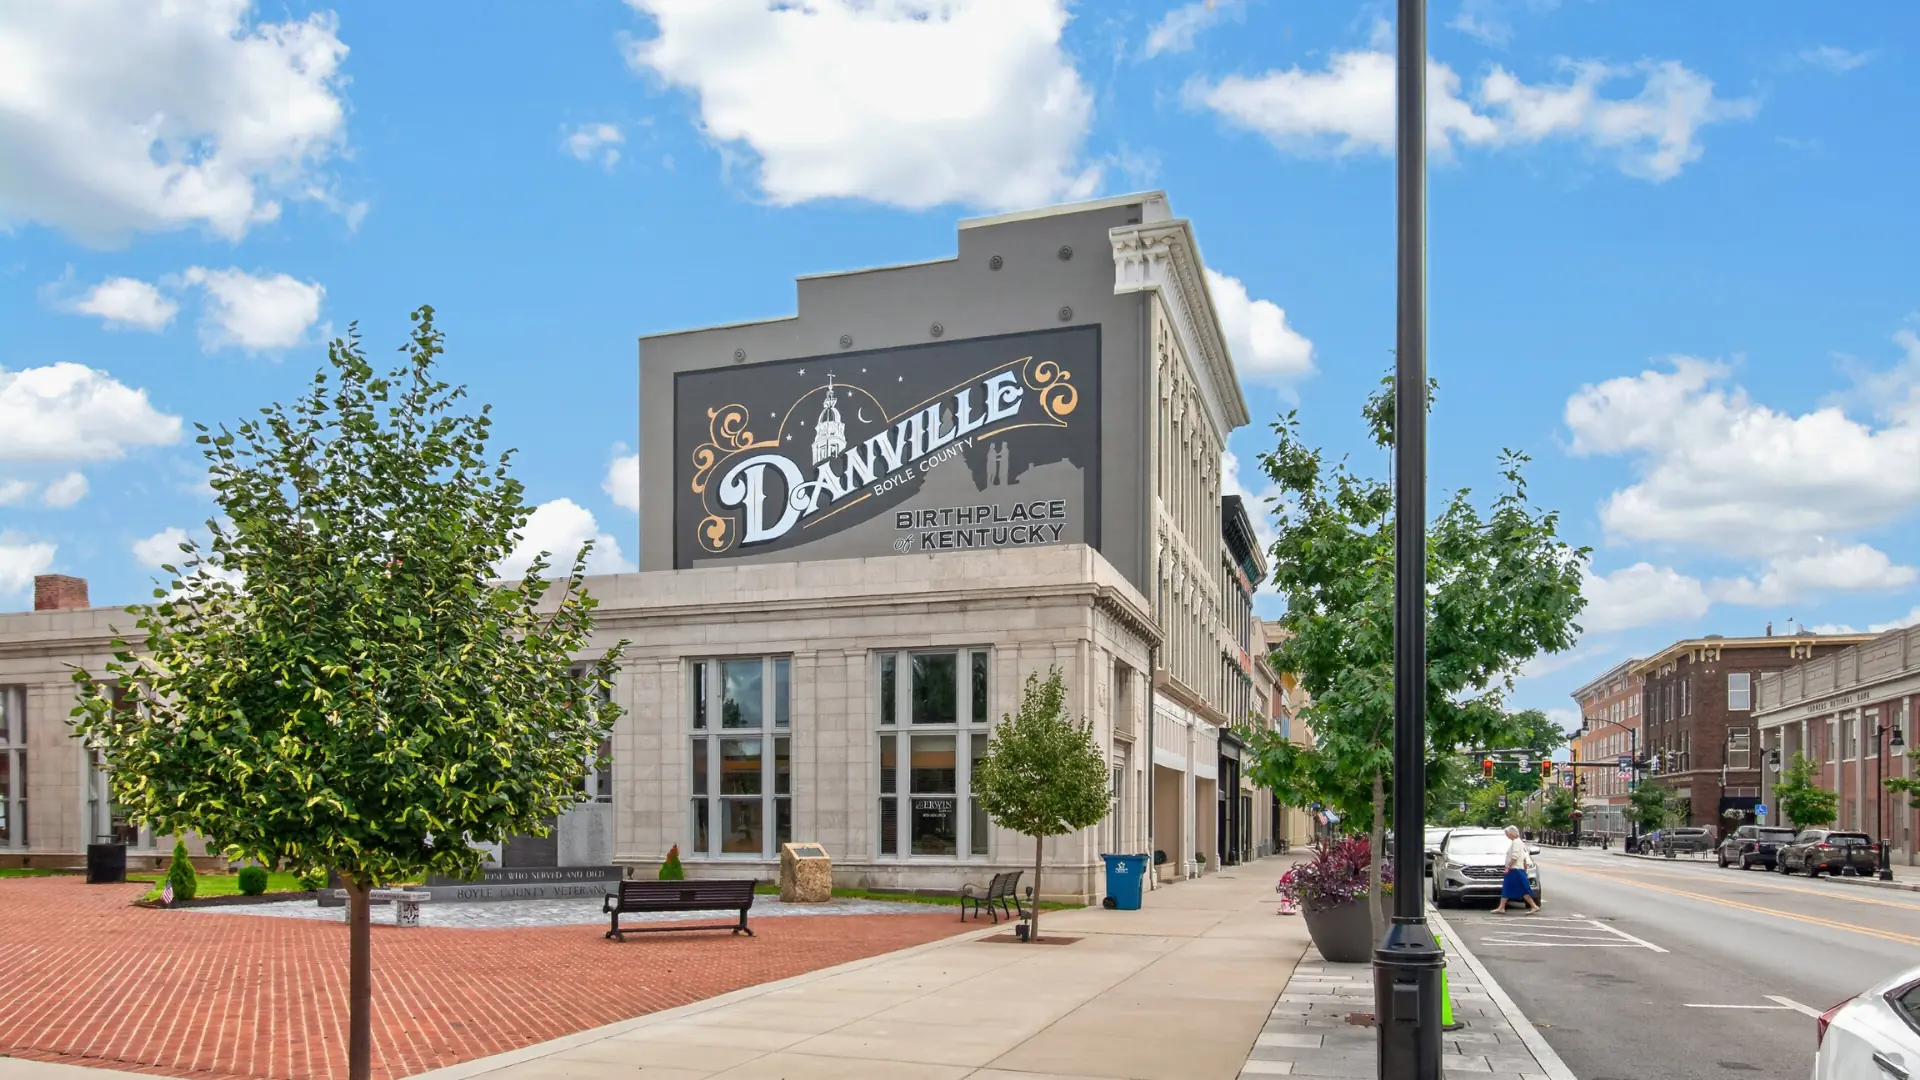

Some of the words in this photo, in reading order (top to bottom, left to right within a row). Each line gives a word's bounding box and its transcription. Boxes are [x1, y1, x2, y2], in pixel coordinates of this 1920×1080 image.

[719, 370, 1024, 544] DANVILLE
[873, 467, 916, 497] BOYLE
[919, 436, 974, 473] COUNTY
[895, 499, 1066, 530] BIRTHPLACE
[894, 533, 914, 554] of
[920, 522, 1067, 551] KENTUCKY
[508, 871, 528, 880] WHO
[531, 870, 562, 880] SERVED
[566, 870, 583, 879] AND
[586, 870, 605, 878] DIED
[457, 887, 493, 899] BOYLE
[501, 886, 545, 899] COUNTY
[553, 884, 607, 896] VETERANS
